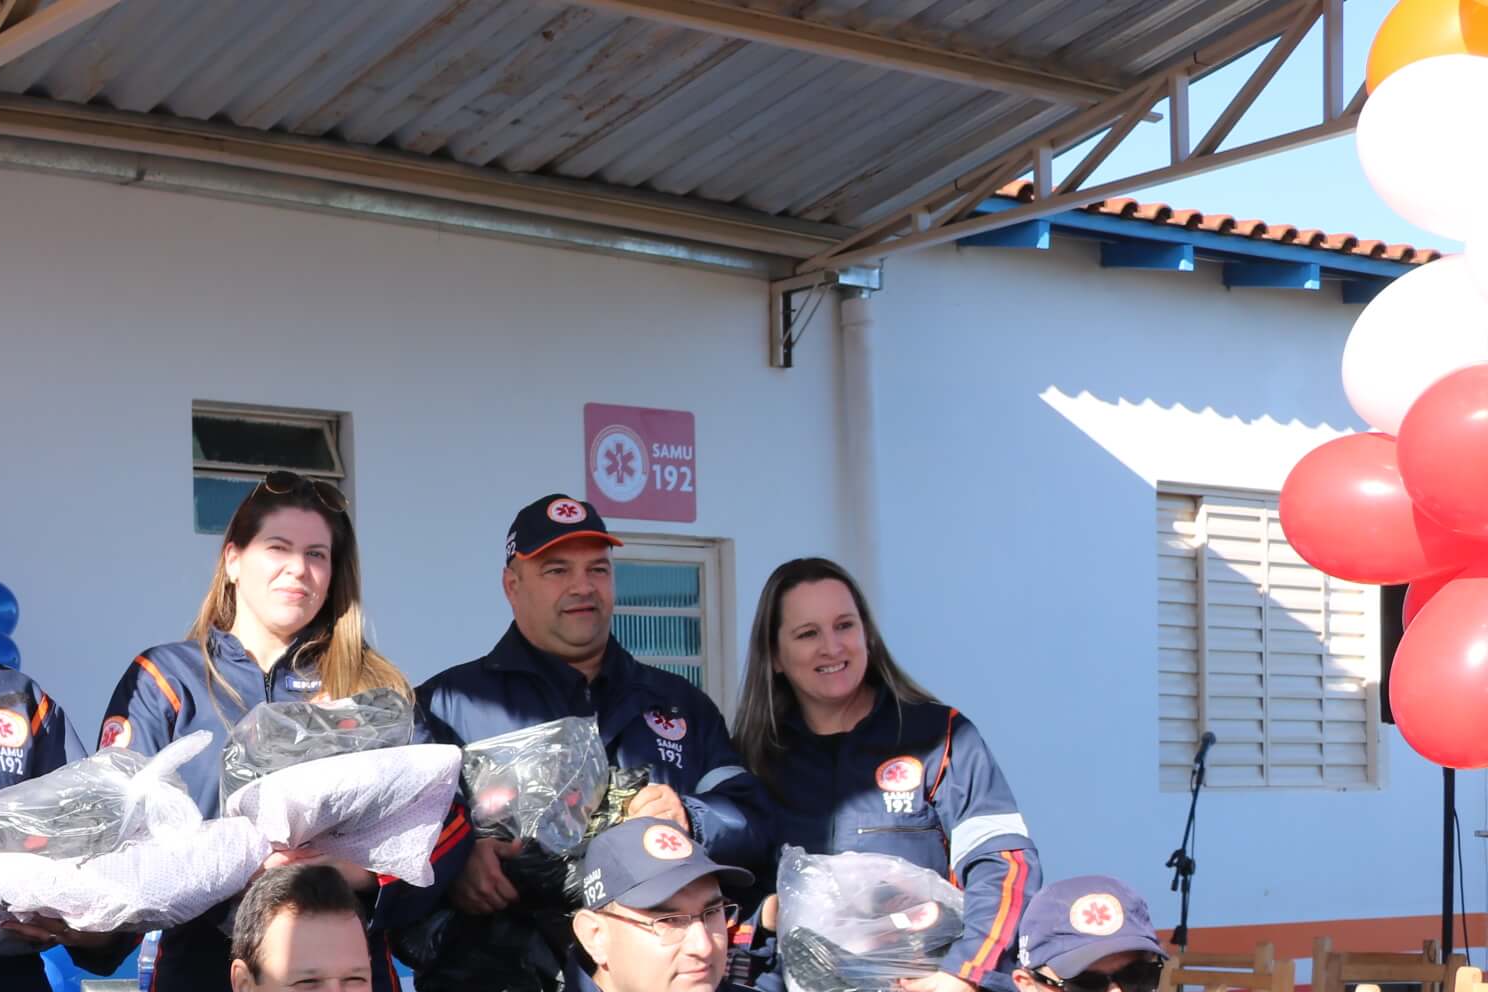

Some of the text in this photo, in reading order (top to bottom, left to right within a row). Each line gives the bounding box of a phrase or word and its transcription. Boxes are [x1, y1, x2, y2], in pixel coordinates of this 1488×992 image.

[652, 442, 693, 461] SAMU
[652, 463, 693, 493] 192
[657, 747, 683, 769] 192
[884, 799, 914, 813] 192
[583, 881, 607, 907] 192
